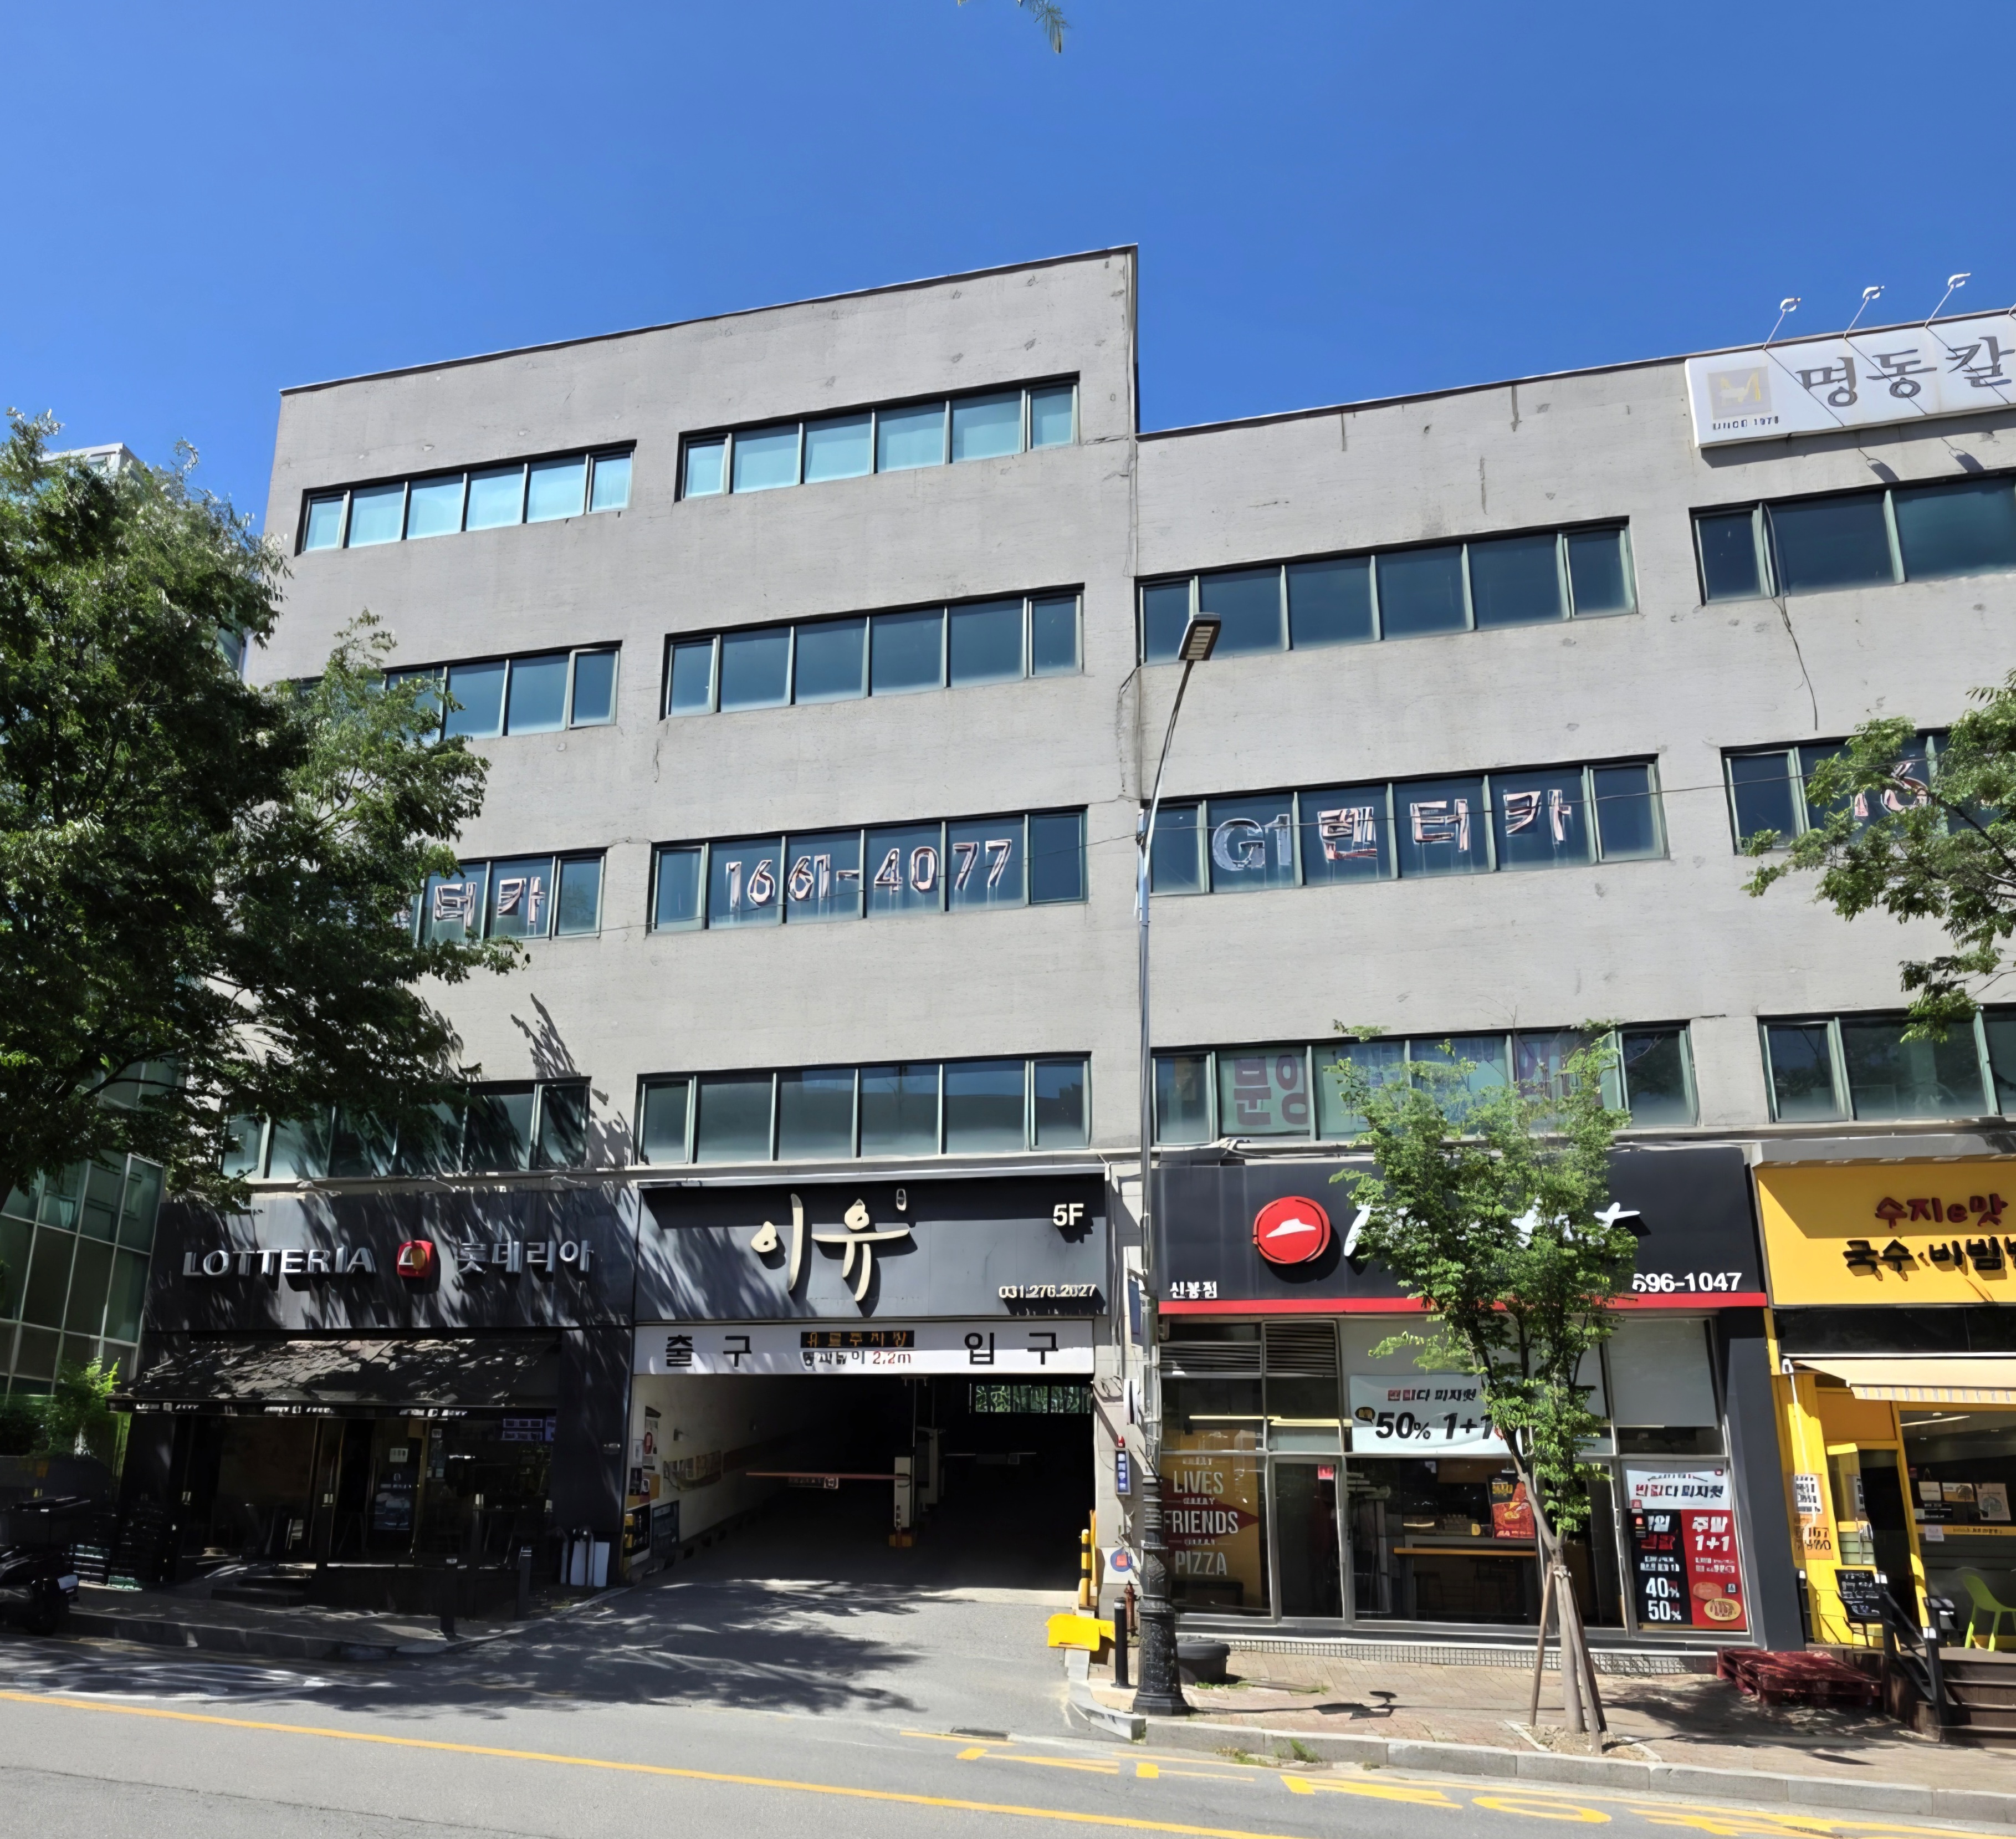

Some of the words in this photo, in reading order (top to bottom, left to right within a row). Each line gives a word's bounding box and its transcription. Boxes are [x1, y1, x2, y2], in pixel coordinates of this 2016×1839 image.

[1796, 336, 2015, 407] 명동칼
[726, 839, 1012, 911] 1661-4077
[1053, 1203, 1084, 1226] 5F
[183, 1246, 376, 1276] LOTTERIA
[457, 1240, 594, 1274] 롯데리아
[1375, 1412, 1431, 1439] 50%
[1174, 1470, 1224, 1494] LIVES
[1695, 1535, 1730, 1551] 1+1
[1175, 1550, 1227, 1576] PIZZA
